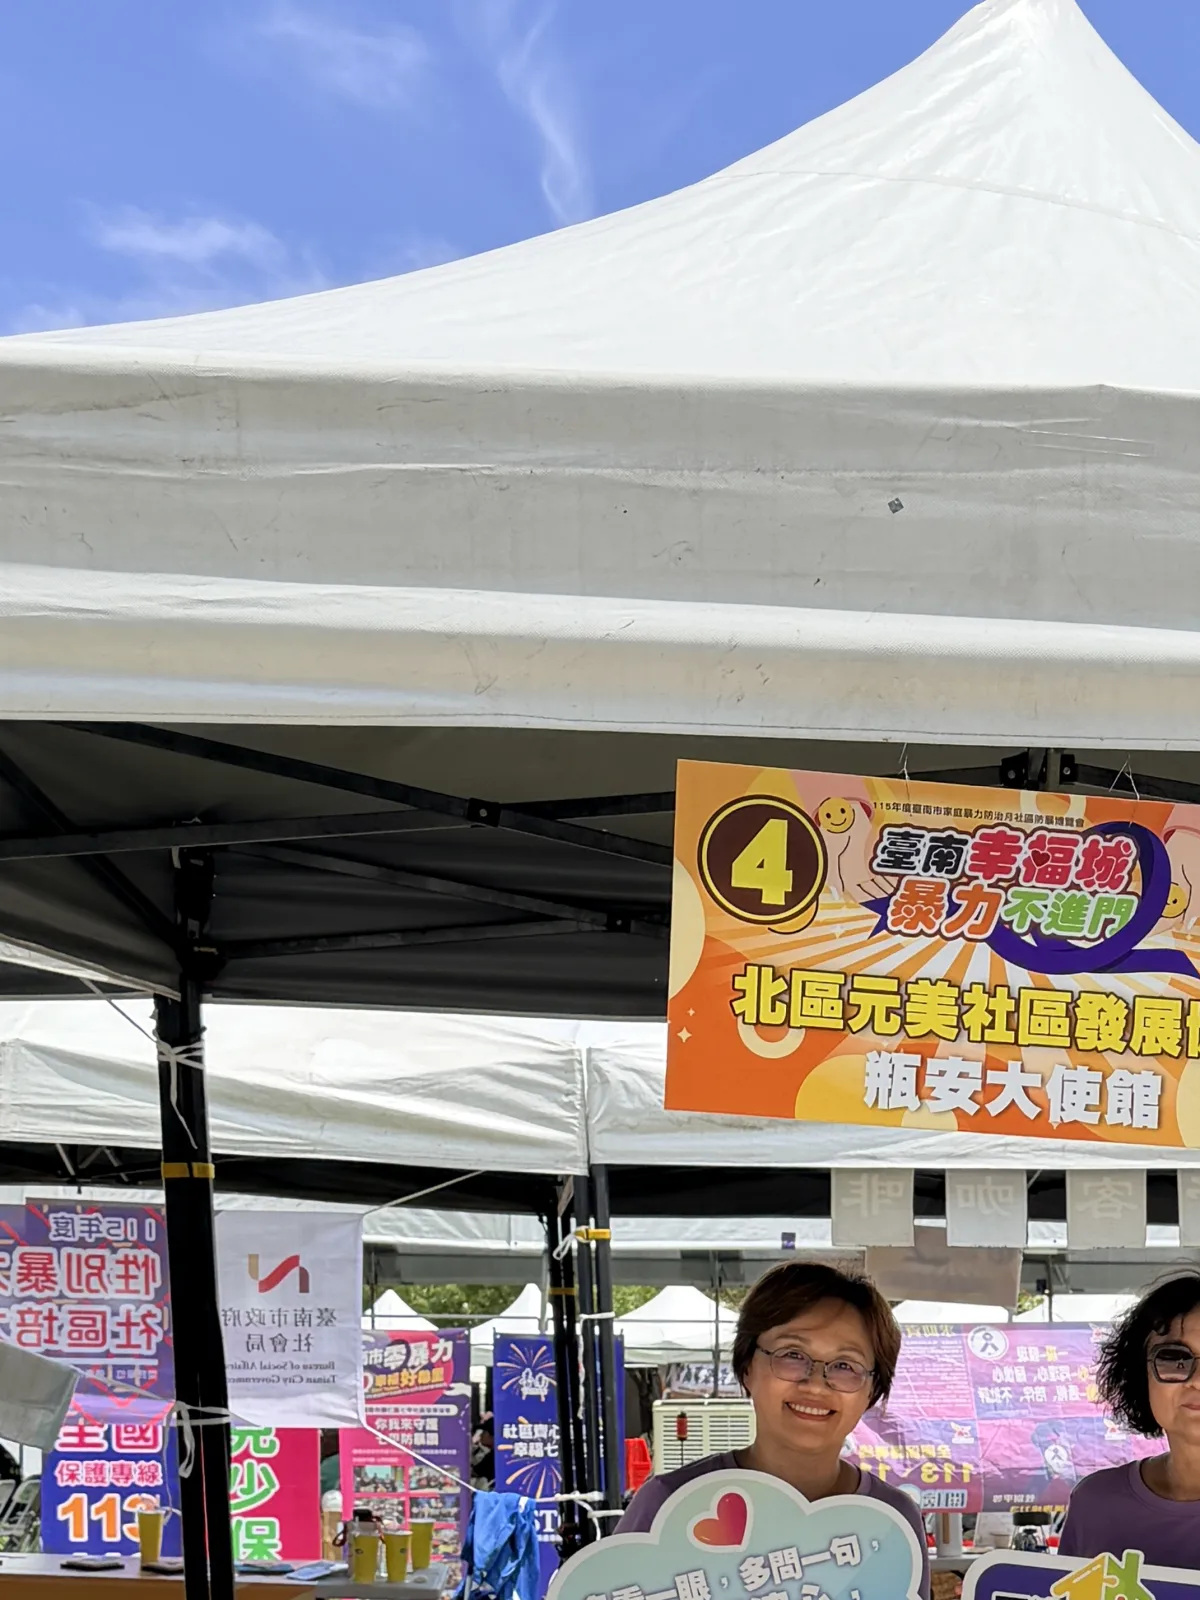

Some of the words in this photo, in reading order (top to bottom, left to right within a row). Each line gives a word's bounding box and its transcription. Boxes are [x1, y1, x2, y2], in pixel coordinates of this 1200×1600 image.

[730, 819, 794, 907] 4
[873, 827, 1136, 893] 臺南幸福城
[888, 878, 1138, 938] 暴力不進門
[863, 1052, 1164, 1131] 瓶安大使館
[57, 1459, 164, 1488] 保護專線
